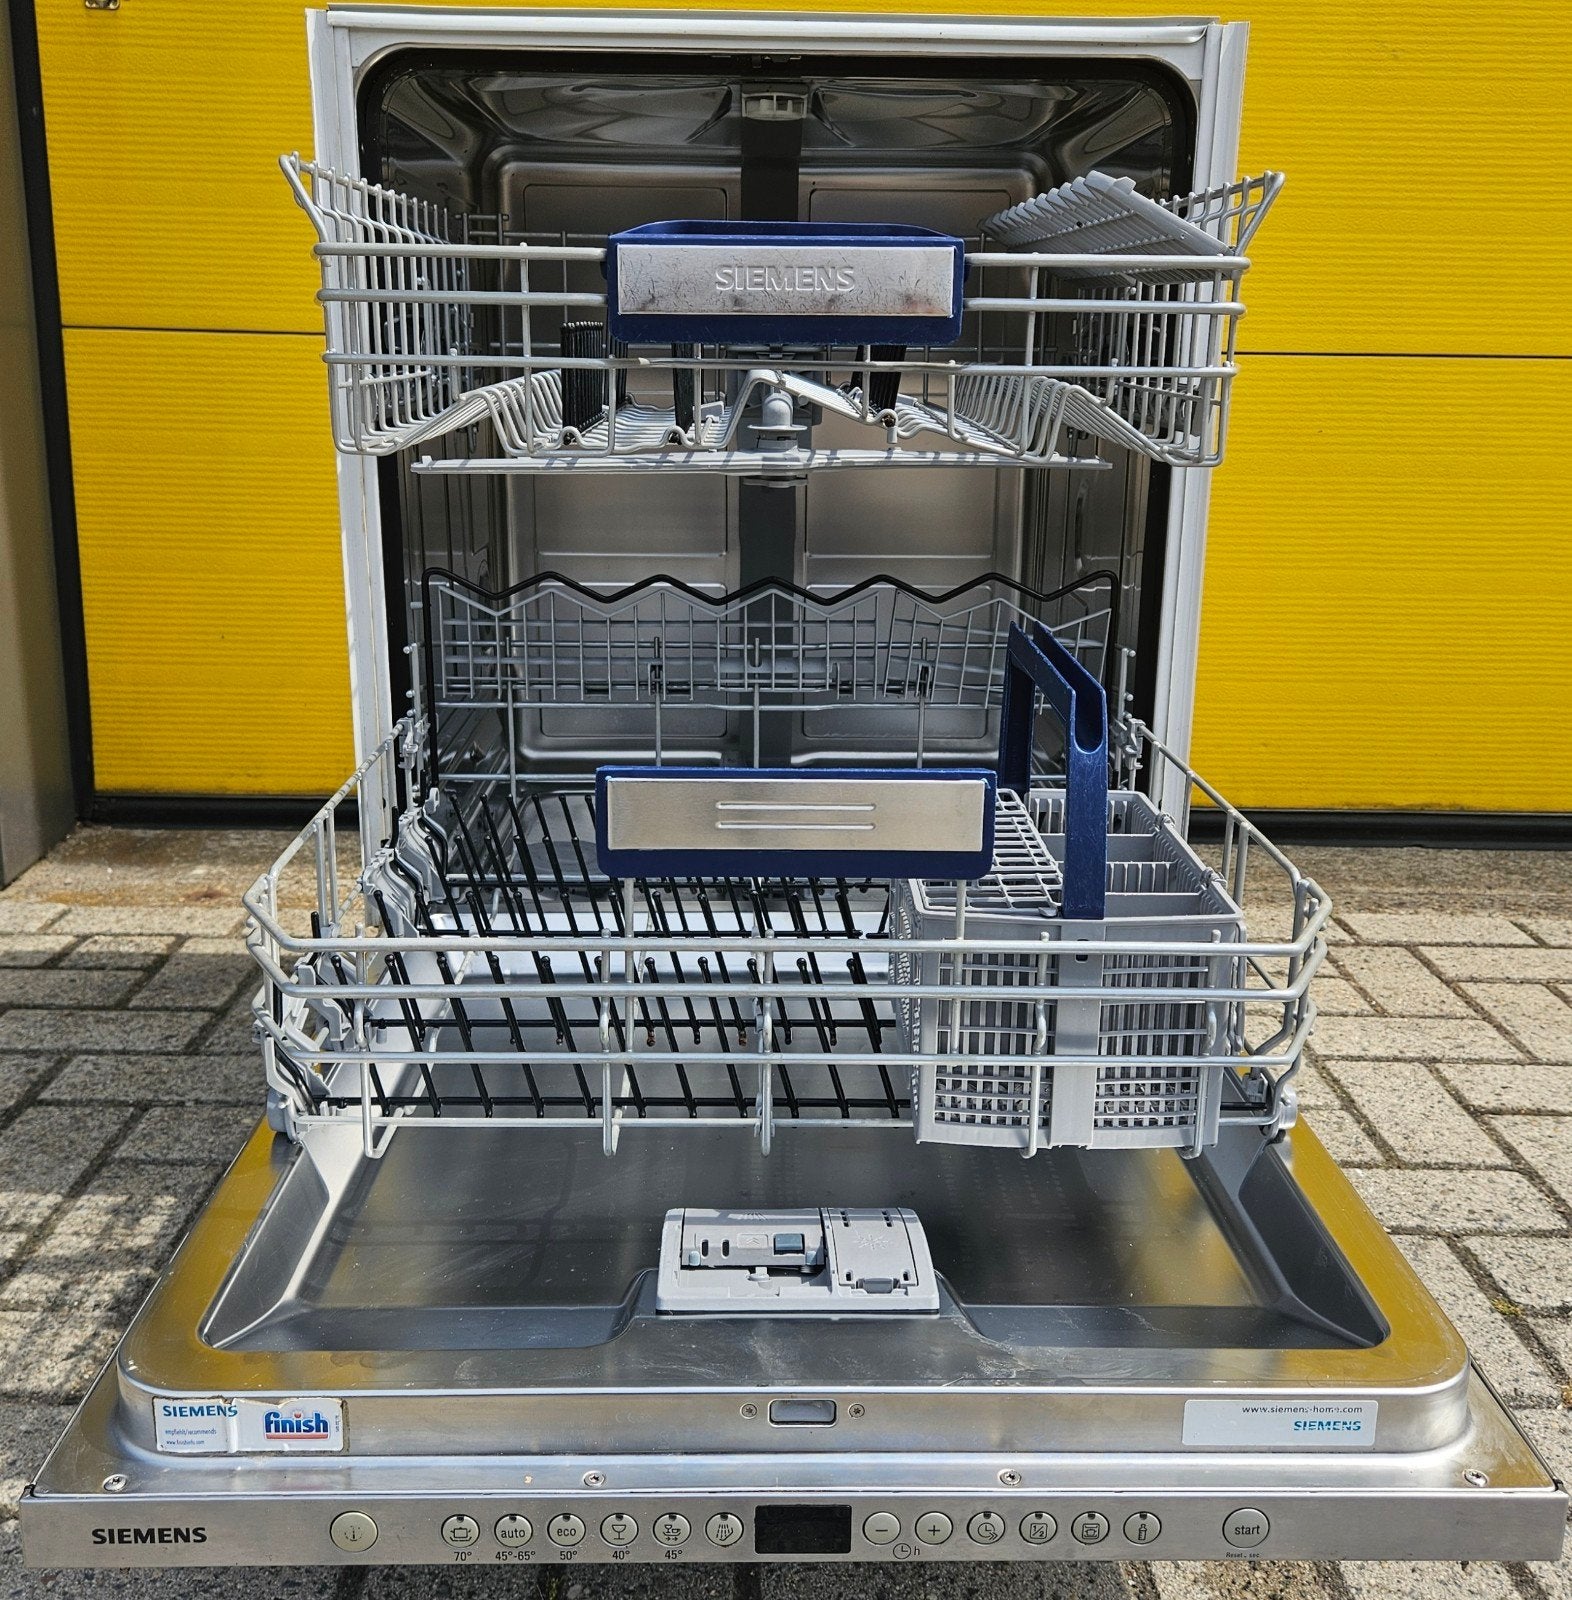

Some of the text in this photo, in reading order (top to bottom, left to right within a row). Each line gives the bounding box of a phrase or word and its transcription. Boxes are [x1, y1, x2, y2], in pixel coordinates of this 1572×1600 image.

[714, 265, 856, 292] SIEMENS
[162, 1405, 238, 1417] SIEMENS
[264, 1411, 329, 1433] finish
[1293, 1420, 1361, 1431] SIEMENS
[91, 1527, 207, 1544] SIEMENS
[500, 1527, 526, 1539] auto
[556, 1527, 577, 1538] eco
[1234, 1525, 1261, 1536] start
[453, 1551, 472, 1562] 70°
[494, 1550, 536, 1562] 45°-65°
[559, 1549, 578, 1561] 50°
[611, 1549, 631, 1560] 40°
[664, 1549, 683, 1560] 45°
[913, 1547, 921, 1556] h
